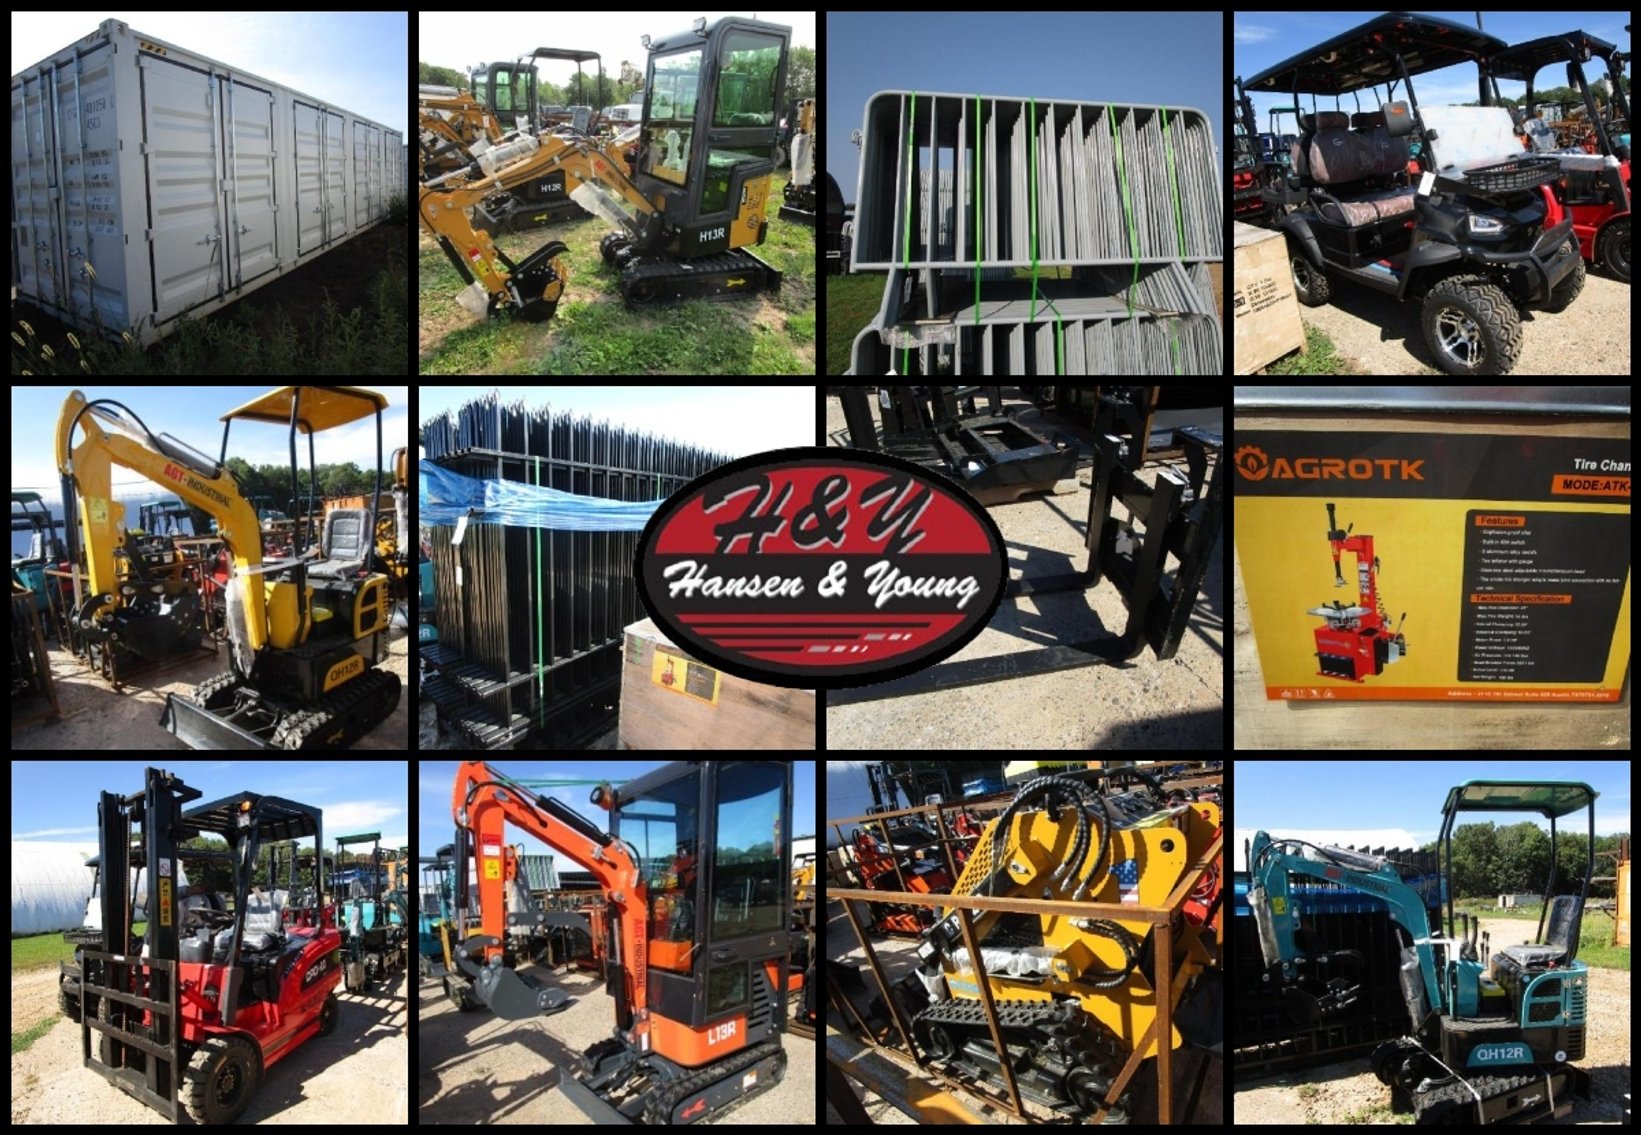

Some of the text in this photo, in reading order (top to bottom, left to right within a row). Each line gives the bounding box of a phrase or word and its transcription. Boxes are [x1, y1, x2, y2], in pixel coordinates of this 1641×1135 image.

[699, 227, 725, 242] H13R
[1271, 458, 1425, 480] AGROTK
[1574, 458, 1631, 472] Tire Chan
[1481, 516, 1519, 525] Features
[1515, 596, 1565, 604] Specification
[708, 1020, 736, 1046] L13R
[1477, 1047, 1524, 1061] QH12R
